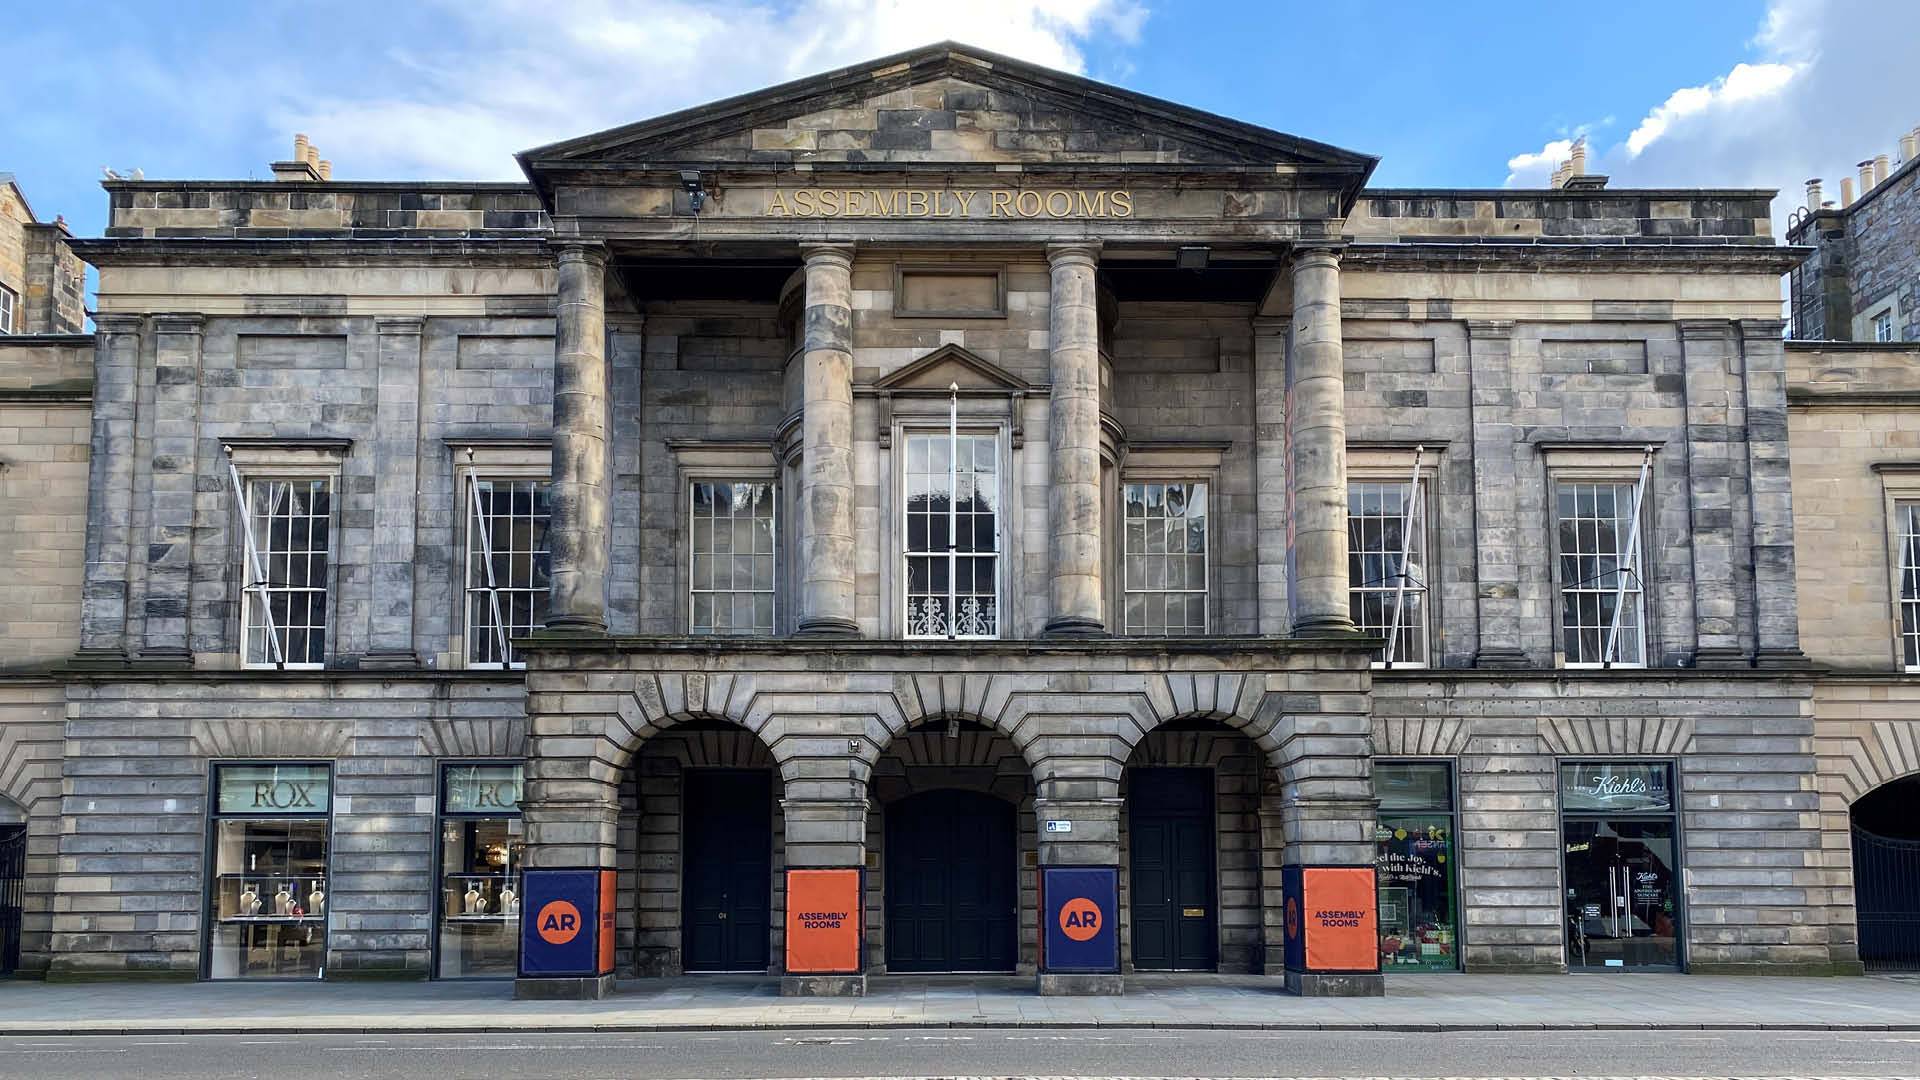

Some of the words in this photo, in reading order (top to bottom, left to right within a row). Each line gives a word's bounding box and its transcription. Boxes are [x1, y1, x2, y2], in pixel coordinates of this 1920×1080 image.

[766, 190, 977, 218] ASSEMBLY
[990, 190, 1133, 218] ROOMS
[1589, 776, 1646, 795] Kiehl's
[251, 781, 316, 808] ROX
[1390, 853, 1405, 861] the
[1407, 854, 1426, 865] Joy.
[1382, 863, 1404, 872] with
[797, 912, 848, 920] ASSEMBLY
[1065, 911, 1097, 928] AR
[1315, 911, 1366, 919] ASSEMBLY
[543, 914, 576, 931] AR
[804, 921, 841, 929] ROOMS
[1322, 919, 1360, 927] ROOMS
